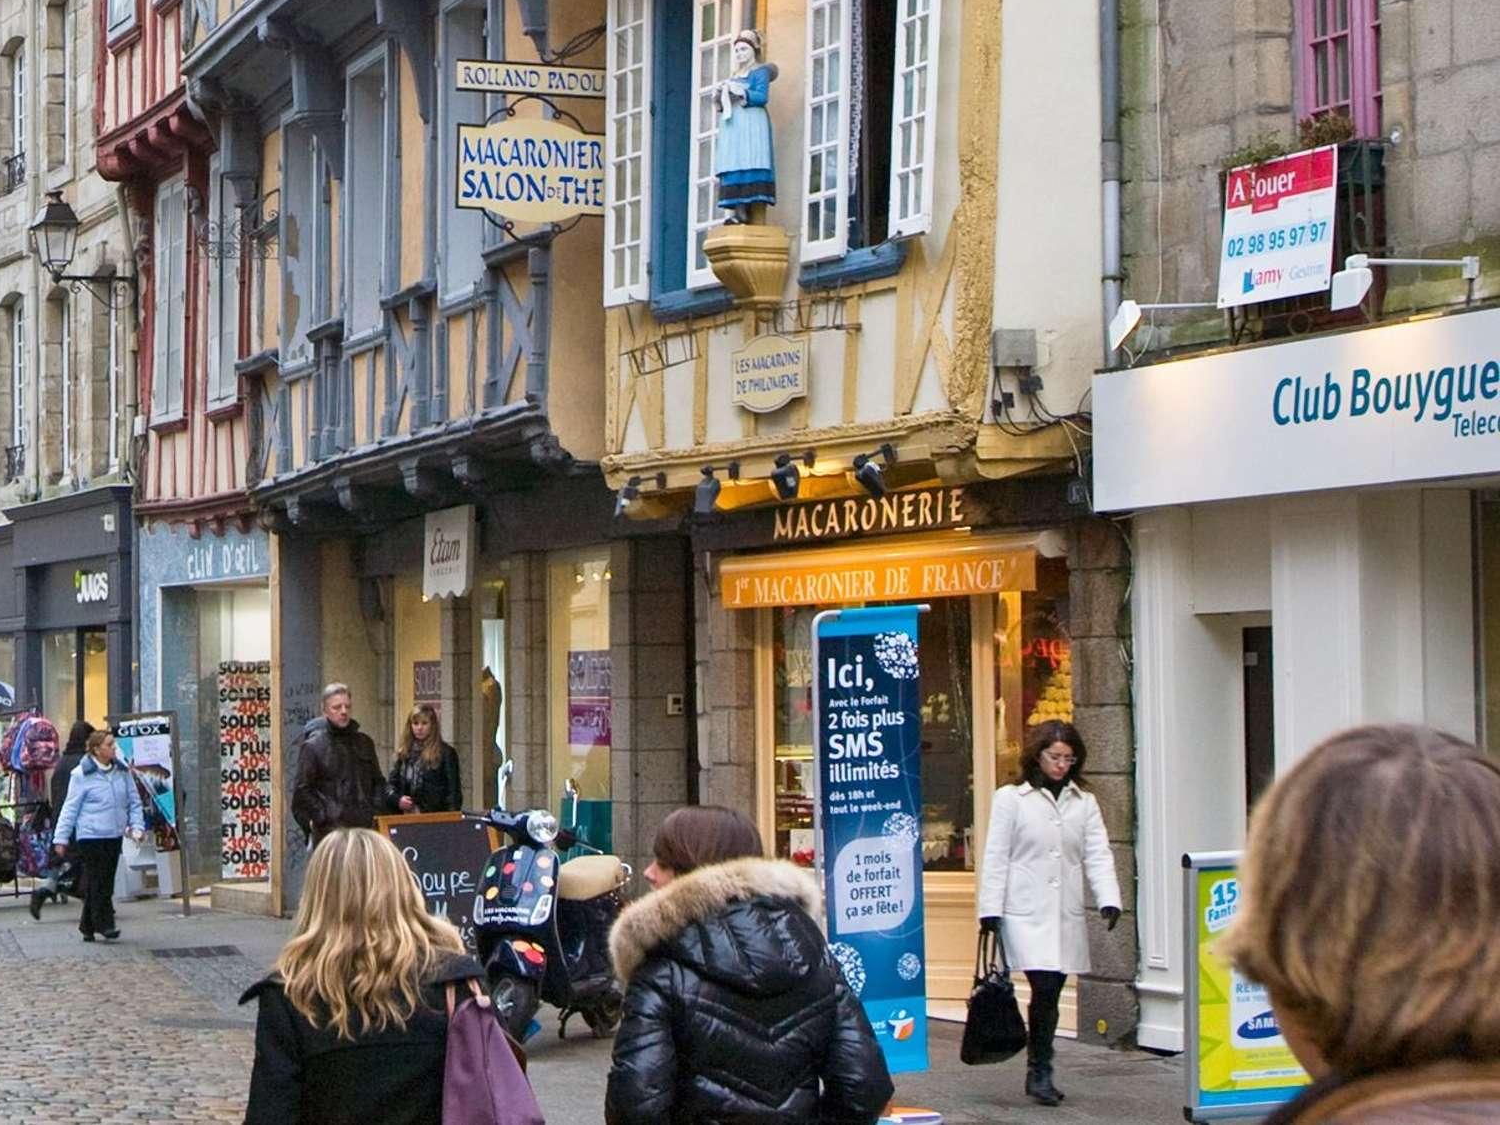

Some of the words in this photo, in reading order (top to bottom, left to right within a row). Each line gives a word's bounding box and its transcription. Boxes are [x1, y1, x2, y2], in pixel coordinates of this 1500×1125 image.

[463, 66, 541, 88] ROLLAND
[462, 169, 547, 202] SALON
[547, 186, 561, 199] DE
[1231, 177, 1246, 204] A
[1251, 171, 1296, 199] louer
[1227, 237, 1244, 258] 02
[1248, 234, 1265, 255] 98
[1268, 230, 1285, 250] 95
[1289, 226, 1306, 247] 97
[1310, 222, 1327, 243] 97
[735, 358, 750, 374] LES
[751, 350, 800, 371] MACARONS
[736, 380, 747, 395] DE
[1273, 373, 1342, 426] Club
[1349, 361, 1500, 423] Bouygue
[773, 488, 966, 541] MACARONERIE
[754, 568, 875, 603] MACARONIER
[885, 567, 910, 595] DE
[922, 559, 1005, 593] FRANCE
[219, 660, 270, 674] SOLDES
[828, 655, 874, 692] Ici,
[219, 687, 270, 703] SOLDES
[829, 698, 849, 708] Avec
[850, 697, 859, 707] le
[861, 695, 889, 706] Forfait
[220, 714, 270, 729] SOLDES
[828, 713, 838, 730] 2
[841, 710, 869, 728] fois
[873, 709, 905, 731] plus
[220, 728, 259, 742] -50%
[220, 743, 235, 756] ET
[828, 731, 884, 759] SMS
[829, 760, 900, 783] illimités
[222, 782, 261, 796] -40%
[829, 792, 845, 802] dès
[848, 790, 864, 801] 18h
[866, 789, 875, 799] et
[830, 805, 848, 814] tout
[850, 804, 859, 813] le
[861, 800, 901, 813] week-end
[222, 824, 237, 838] ET
[223, 836, 261, 850] -30%
[222, 849, 270, 865] SOLDE
[854, 854, 861, 866] 1
[864, 851, 891, 864] mois
[846, 869, 861, 884] de
[864, 867, 901, 883] forfait
[850, 885, 892, 901] OFFERT
[1213, 881, 1237, 906] 15
[845, 905, 858, 920] ça
[862, 903, 873, 916] se
